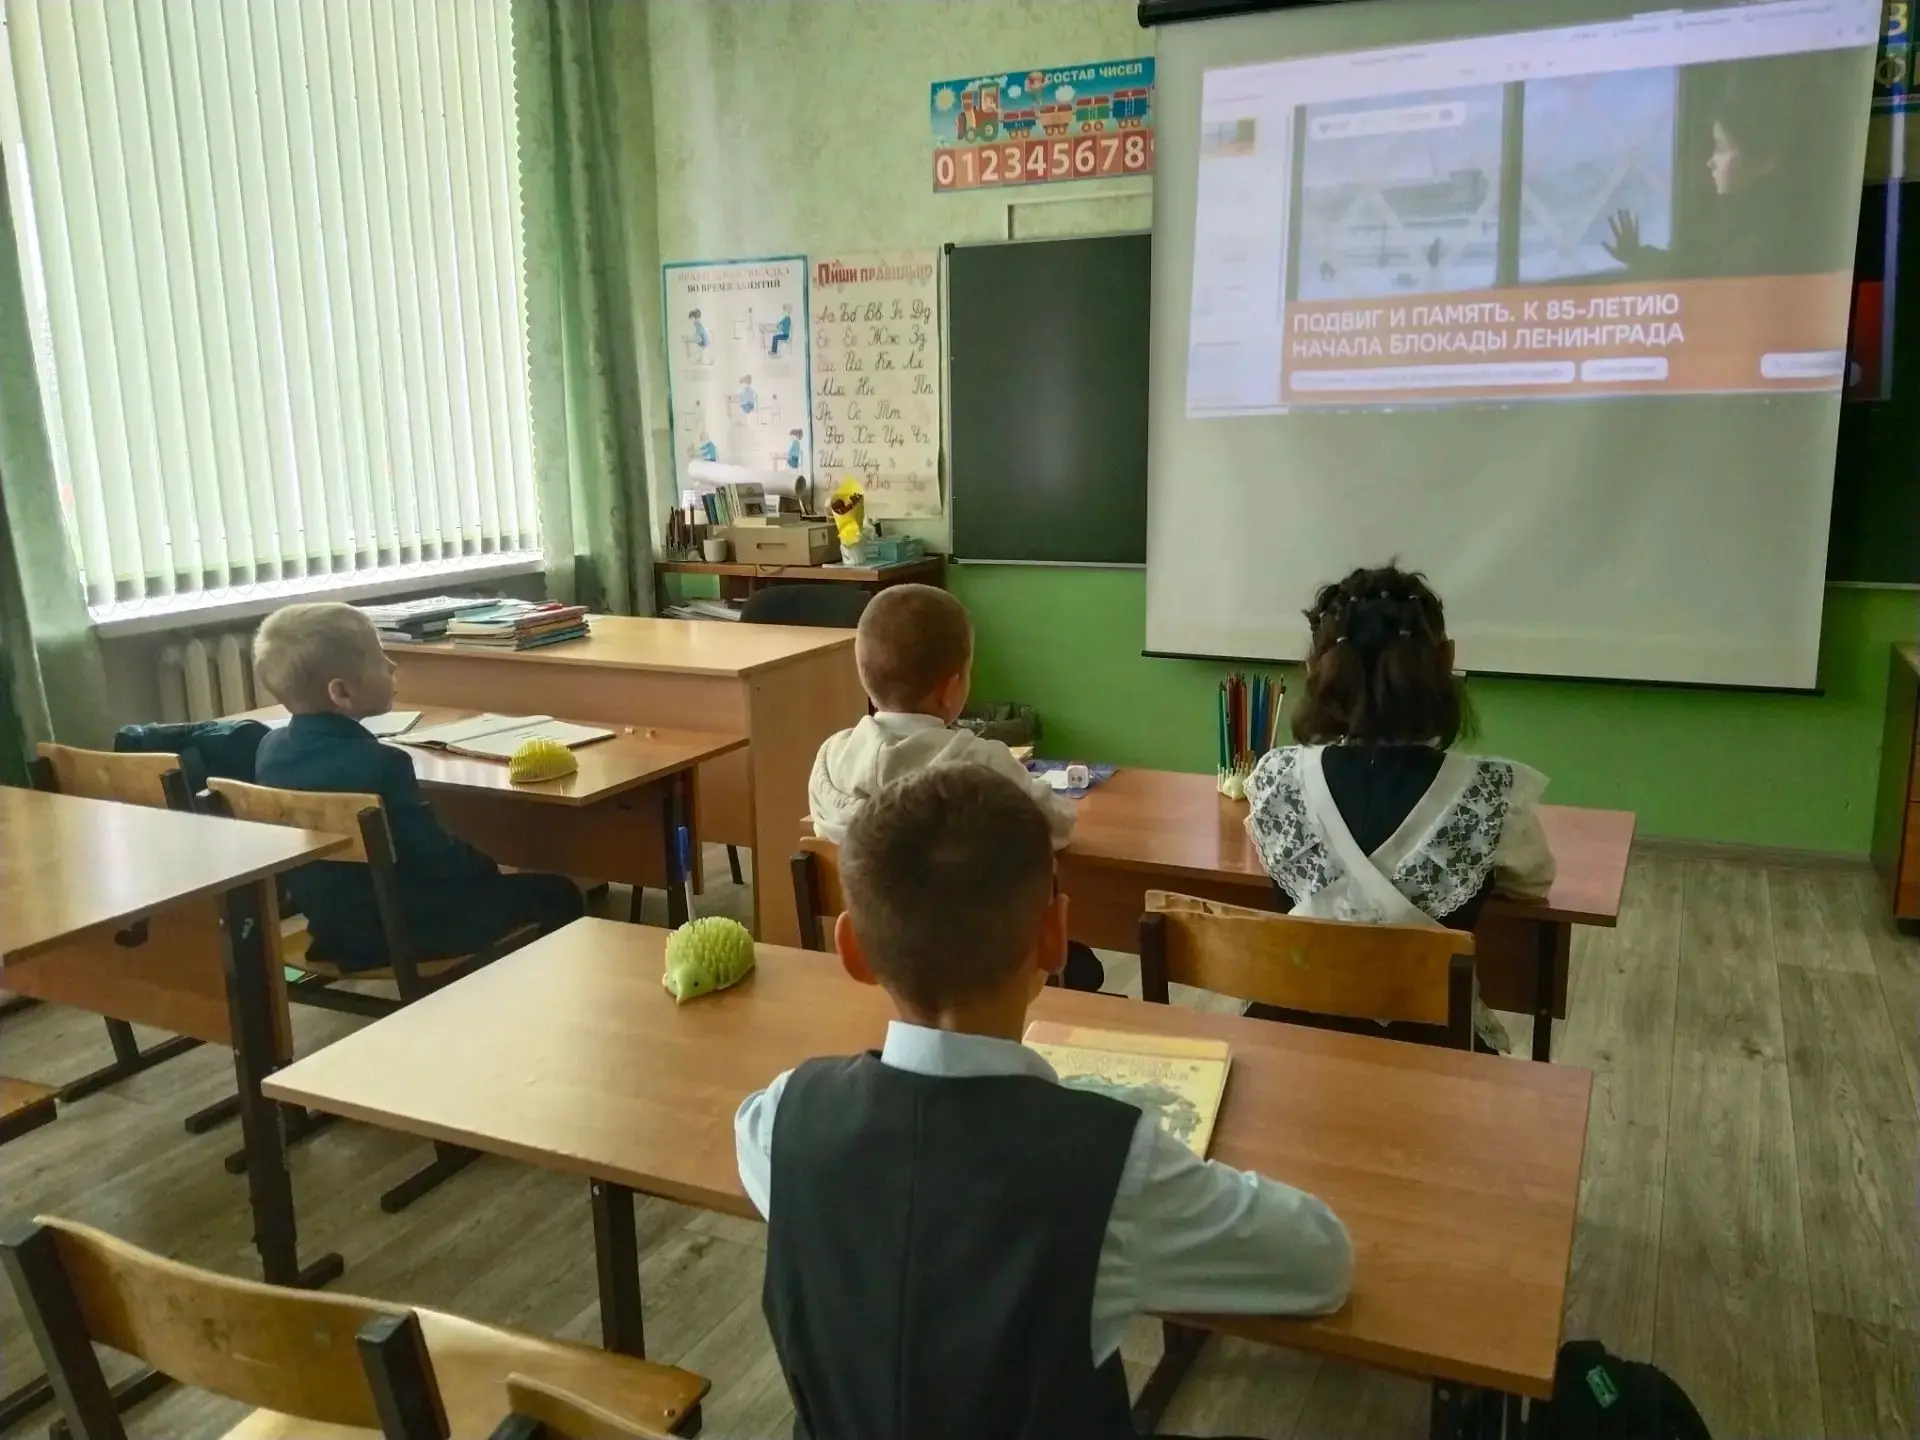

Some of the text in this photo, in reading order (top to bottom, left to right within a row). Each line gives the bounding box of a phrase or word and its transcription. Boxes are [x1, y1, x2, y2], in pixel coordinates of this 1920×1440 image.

[1045, 62, 1143, 84] СОСТАВ ЧИСЕЛ
[936, 135, 1145, 185] 0 1 2 3 4 5 6 7 8
[688, 283, 699, 293] ВО
[1294, 293, 1679, 335] ПОДВИГ И ПАМЯТЬ. К 85-ЛЕТИЮ
[1292, 322, 1685, 357] НАЧАЛА БЛОКАДЫ ЛЕНИНГРАДА
